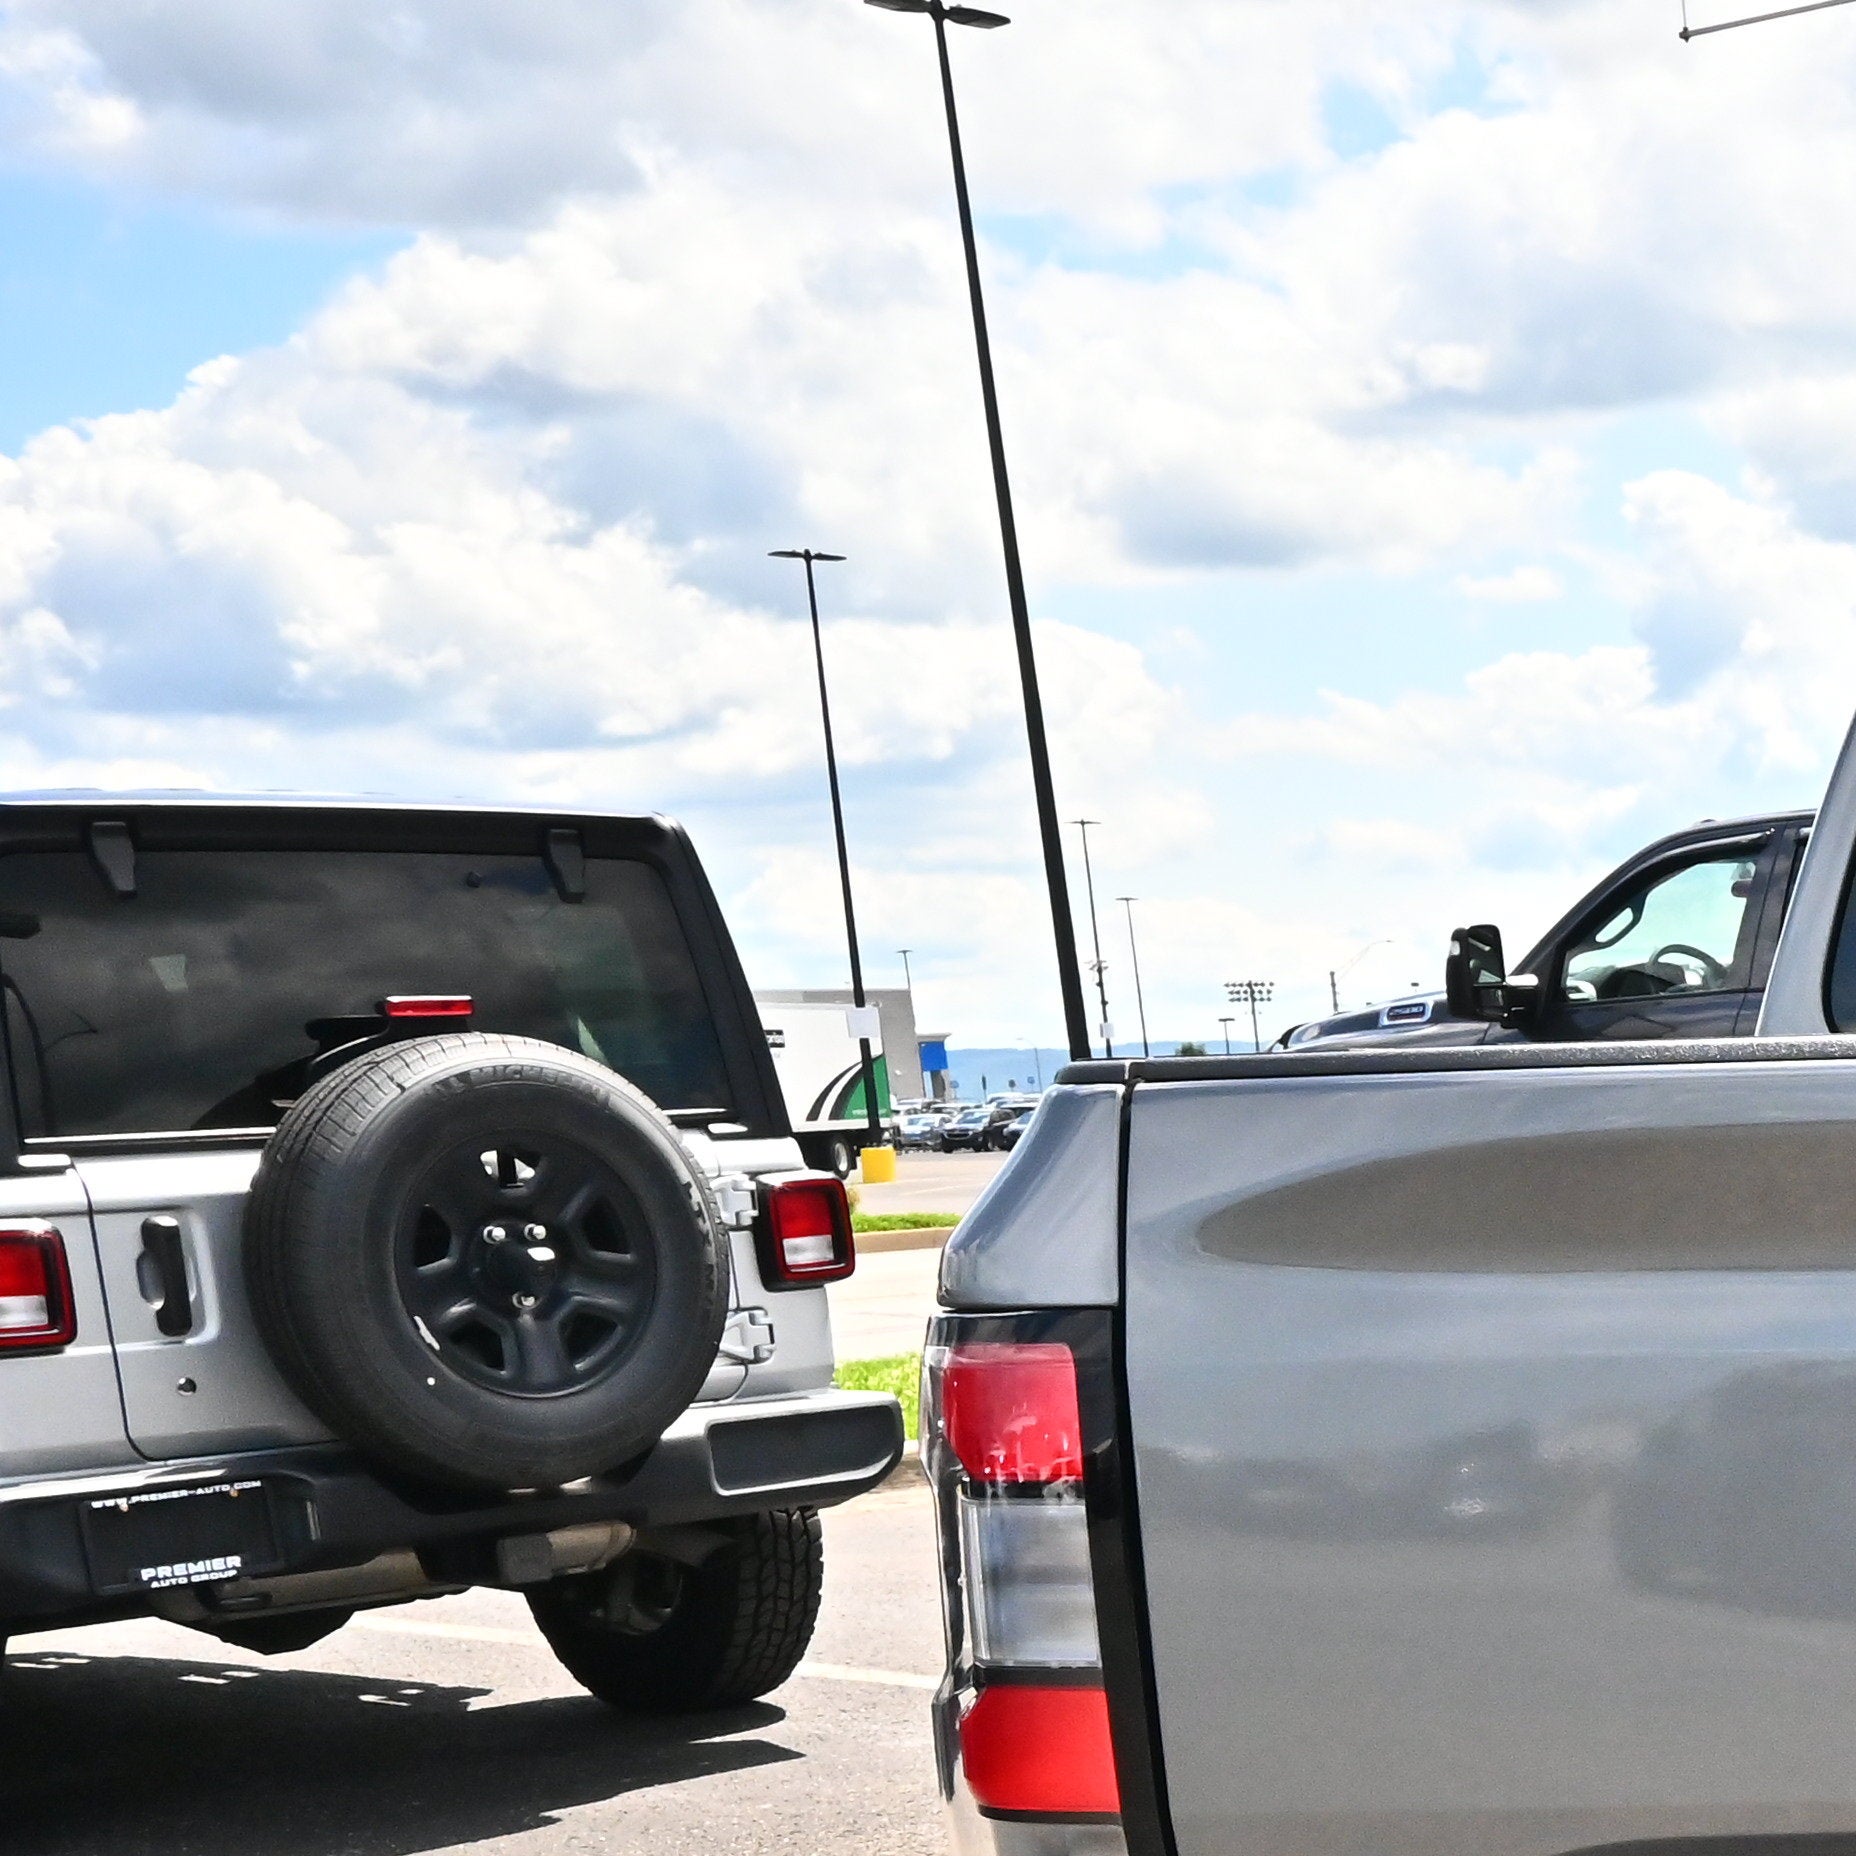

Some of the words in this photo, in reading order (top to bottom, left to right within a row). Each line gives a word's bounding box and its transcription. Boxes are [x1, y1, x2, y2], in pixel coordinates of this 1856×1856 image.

[140, 1555, 242, 1581] PREMIER
[151, 1575, 189, 1588] AUTO
[191, 1569, 238, 1583] GROUP
